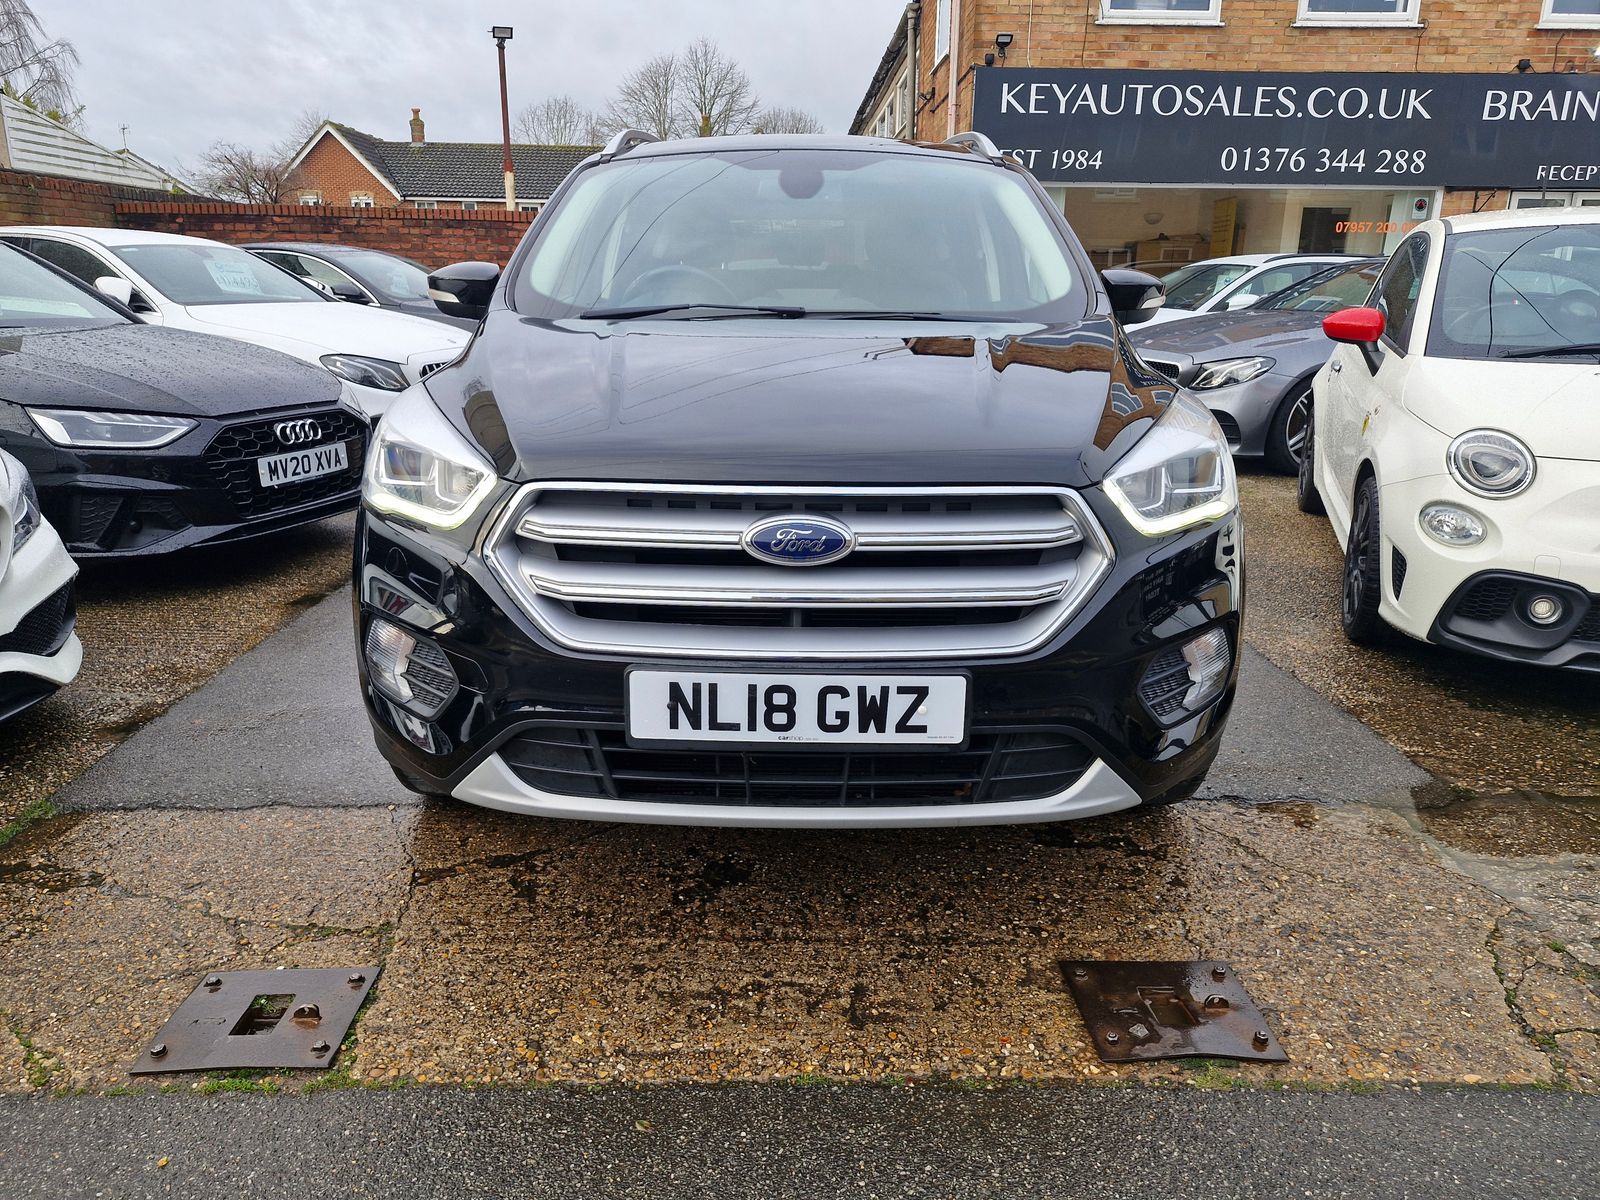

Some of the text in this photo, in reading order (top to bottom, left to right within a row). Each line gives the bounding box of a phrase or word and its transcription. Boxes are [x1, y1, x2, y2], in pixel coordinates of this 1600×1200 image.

[1000, 82, 1433, 120] KEYAUTOSALES.CO.UK
[1051, 149, 1103, 170] 1984
[1220, 146, 1427, 174] 01376 344 288
[1536, 165, 1600, 181] RECEP
[1335, 221, 1374, 233] 07957
[267, 447, 342, 482] MV20 XVA
[770, 528, 827, 552] Ford
[666, 681, 930, 734] NL18 GWZ
